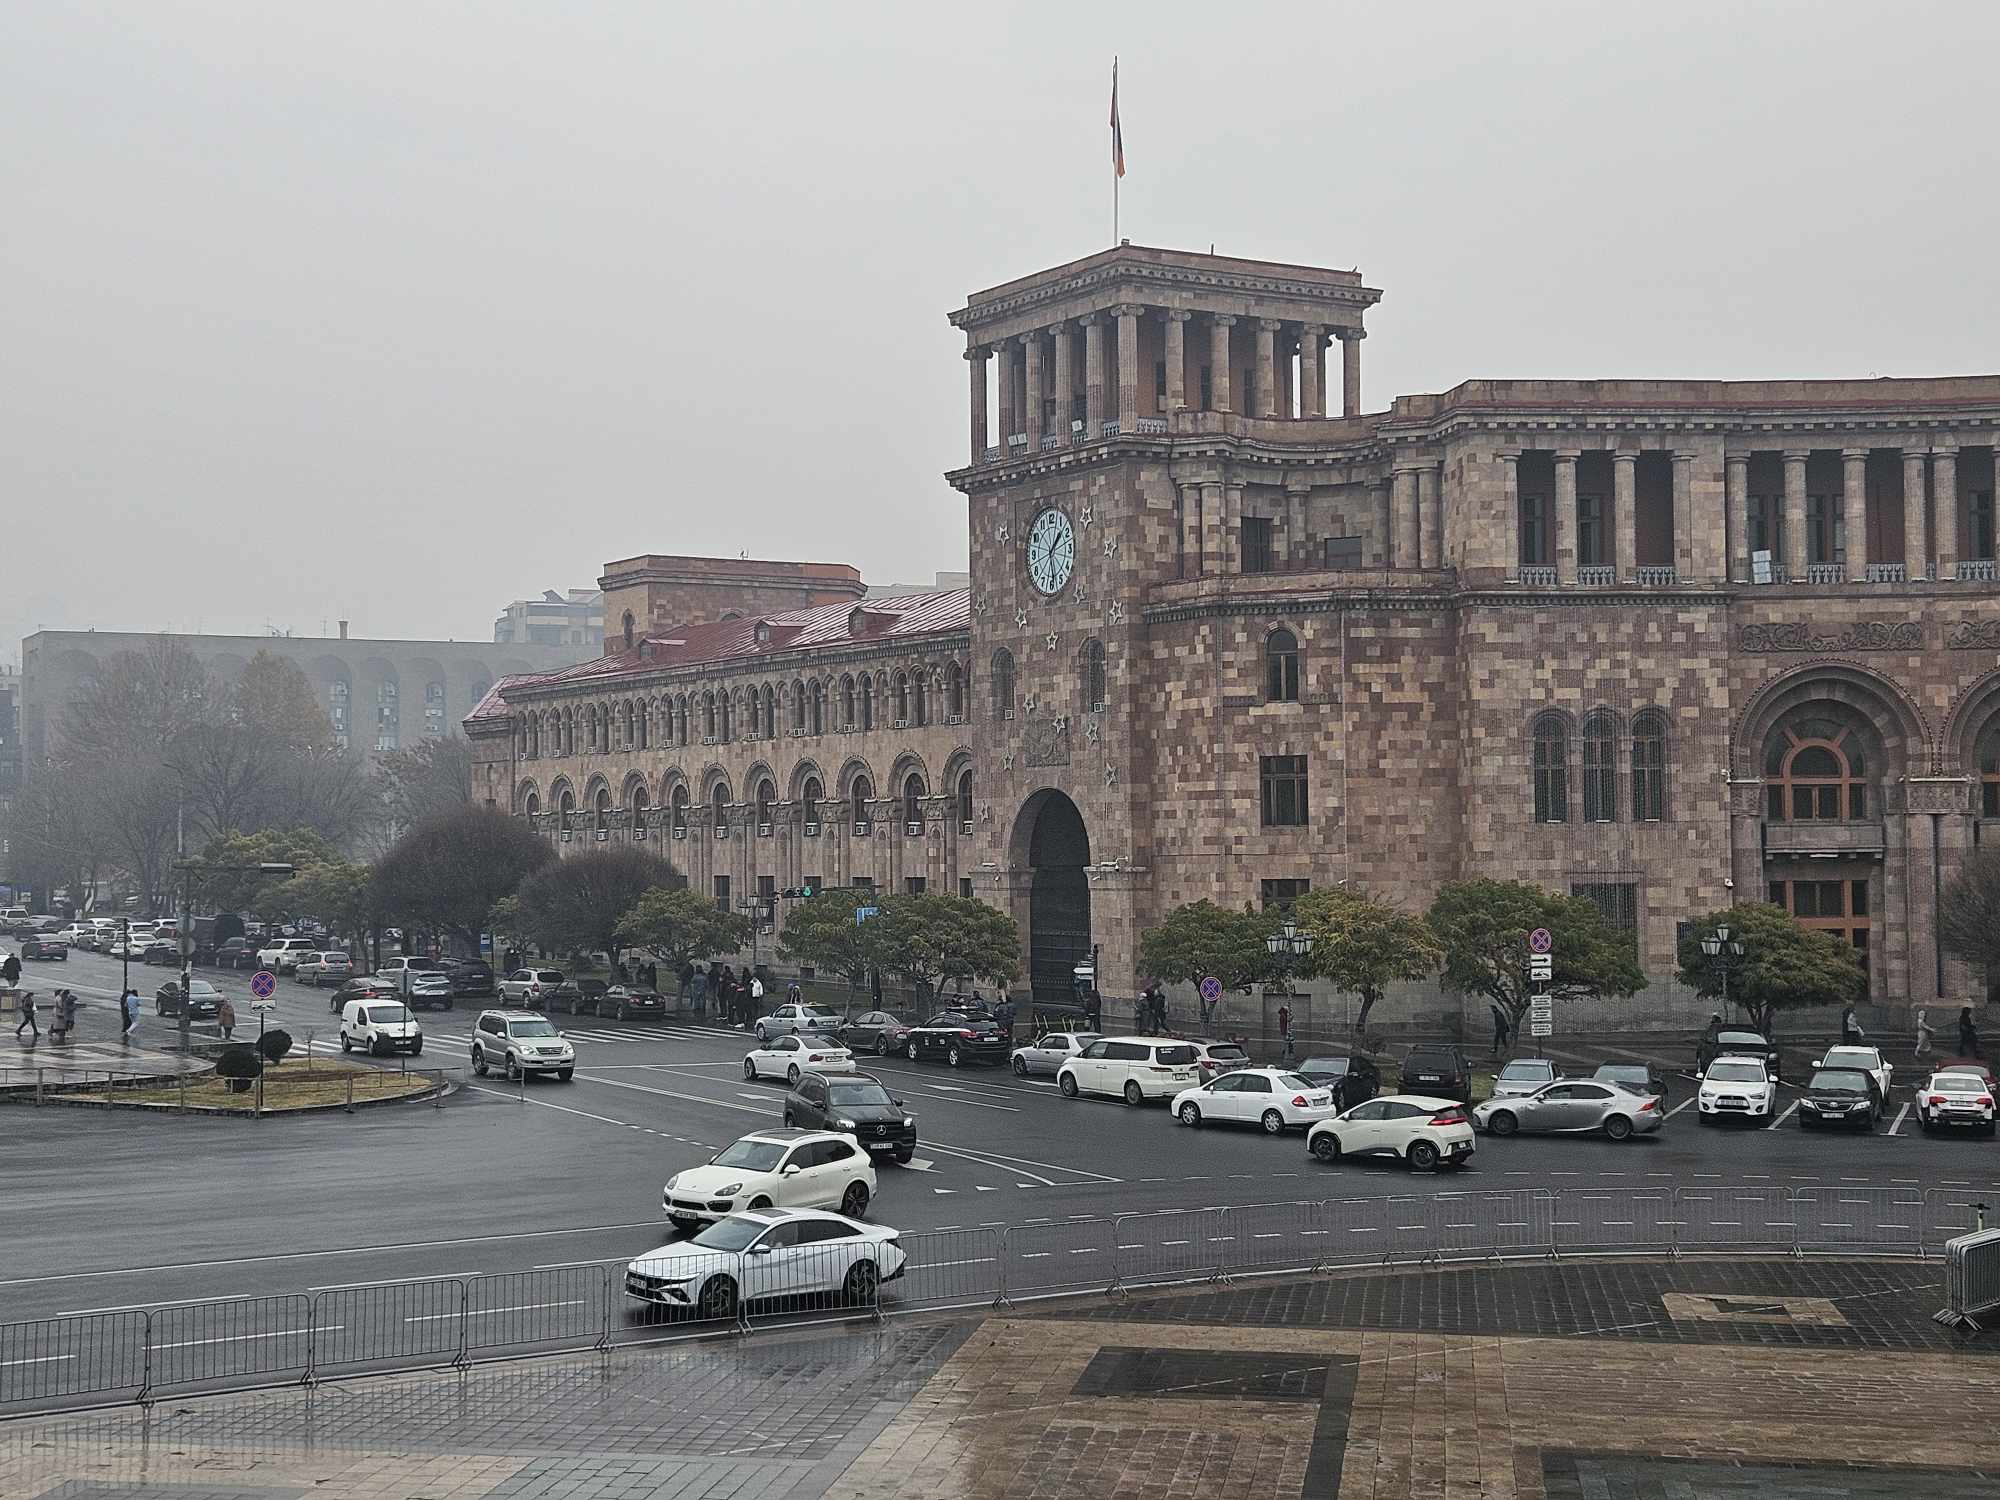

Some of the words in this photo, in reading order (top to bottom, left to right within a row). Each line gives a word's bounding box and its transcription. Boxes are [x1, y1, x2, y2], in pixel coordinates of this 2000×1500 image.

[1048, 513, 1055, 524] 12
[1040, 519, 1045, 530] 11
[1065, 528, 1070, 537] 2
[1068, 544, 1072, 553] 3
[1032, 550, 1036, 560] 9
[1065, 561, 1069, 570] 4
[1034, 566, 1038, 576] 8
[1041, 577, 1045, 587] 7
[1059, 575, 1063, 584] 5
[1050, 580, 1054, 590] 6
